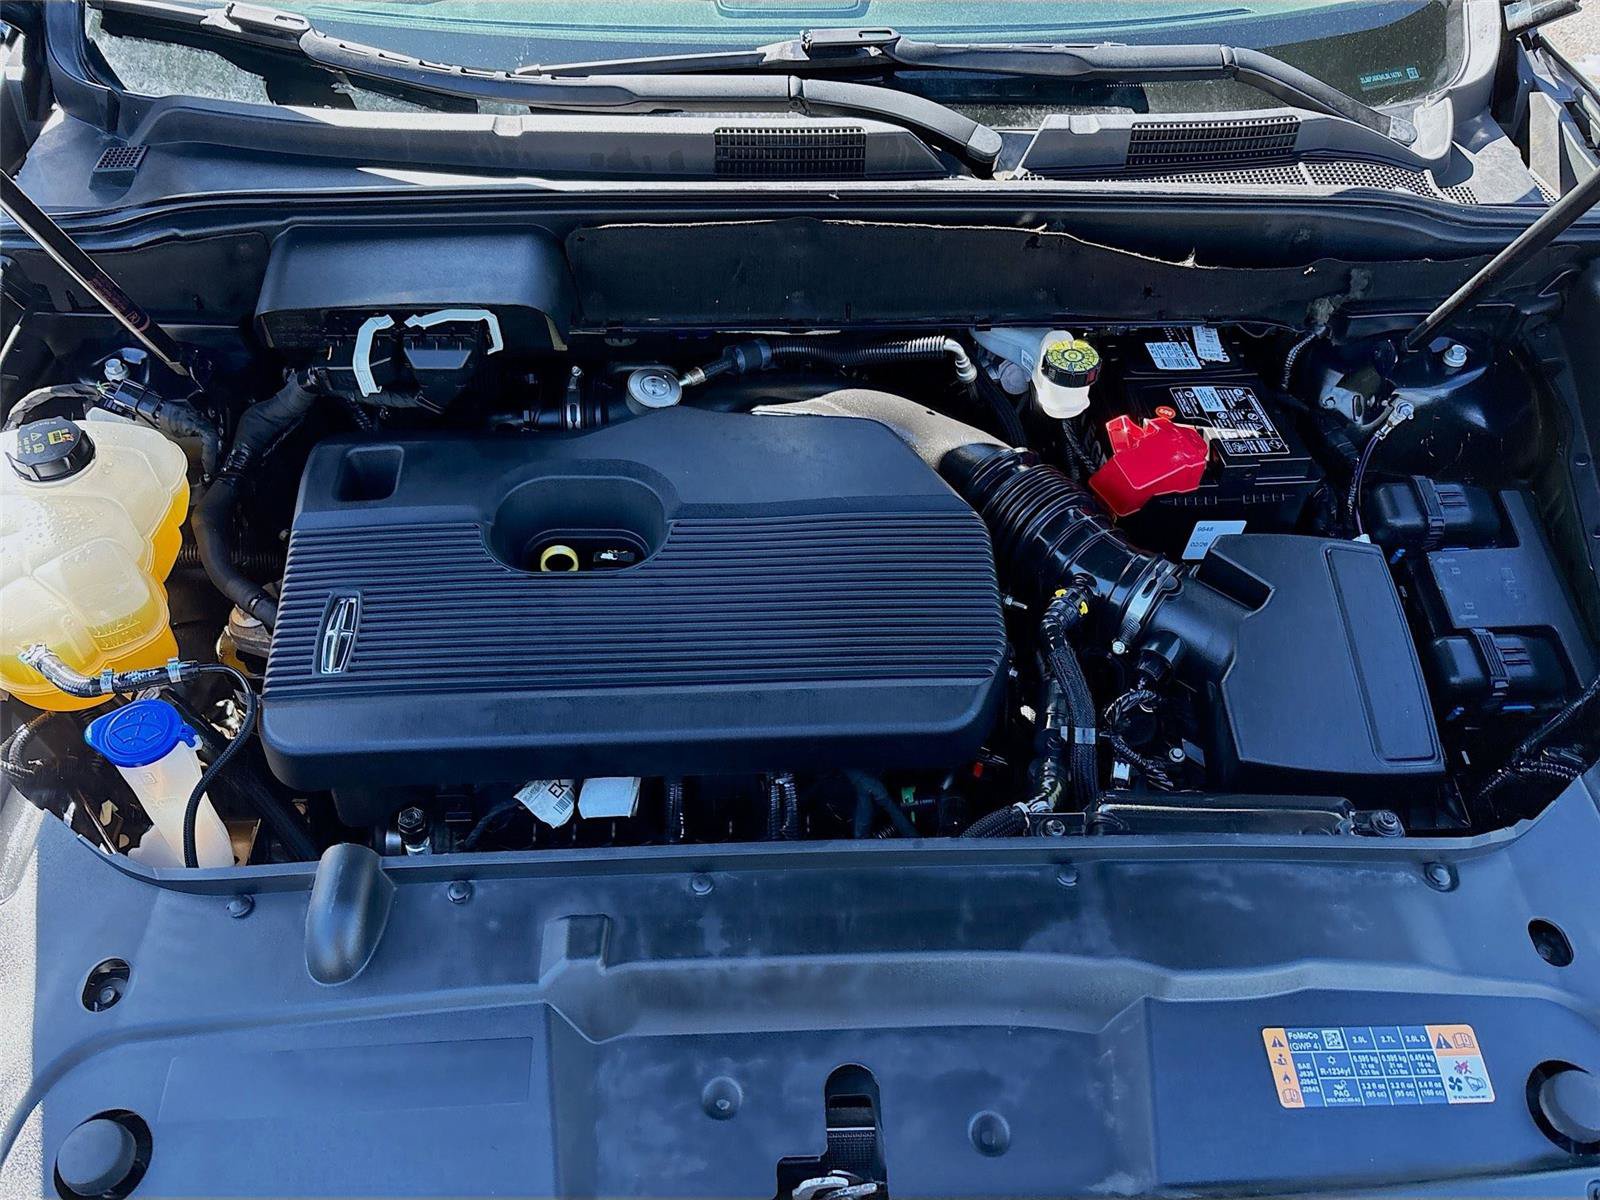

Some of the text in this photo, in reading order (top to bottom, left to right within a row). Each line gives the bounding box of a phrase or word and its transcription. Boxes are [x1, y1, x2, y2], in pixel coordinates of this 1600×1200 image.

[1287, 1031, 1318, 1040] FoMoCo
[1289, 1042, 1322, 1051] (GWP 4)
